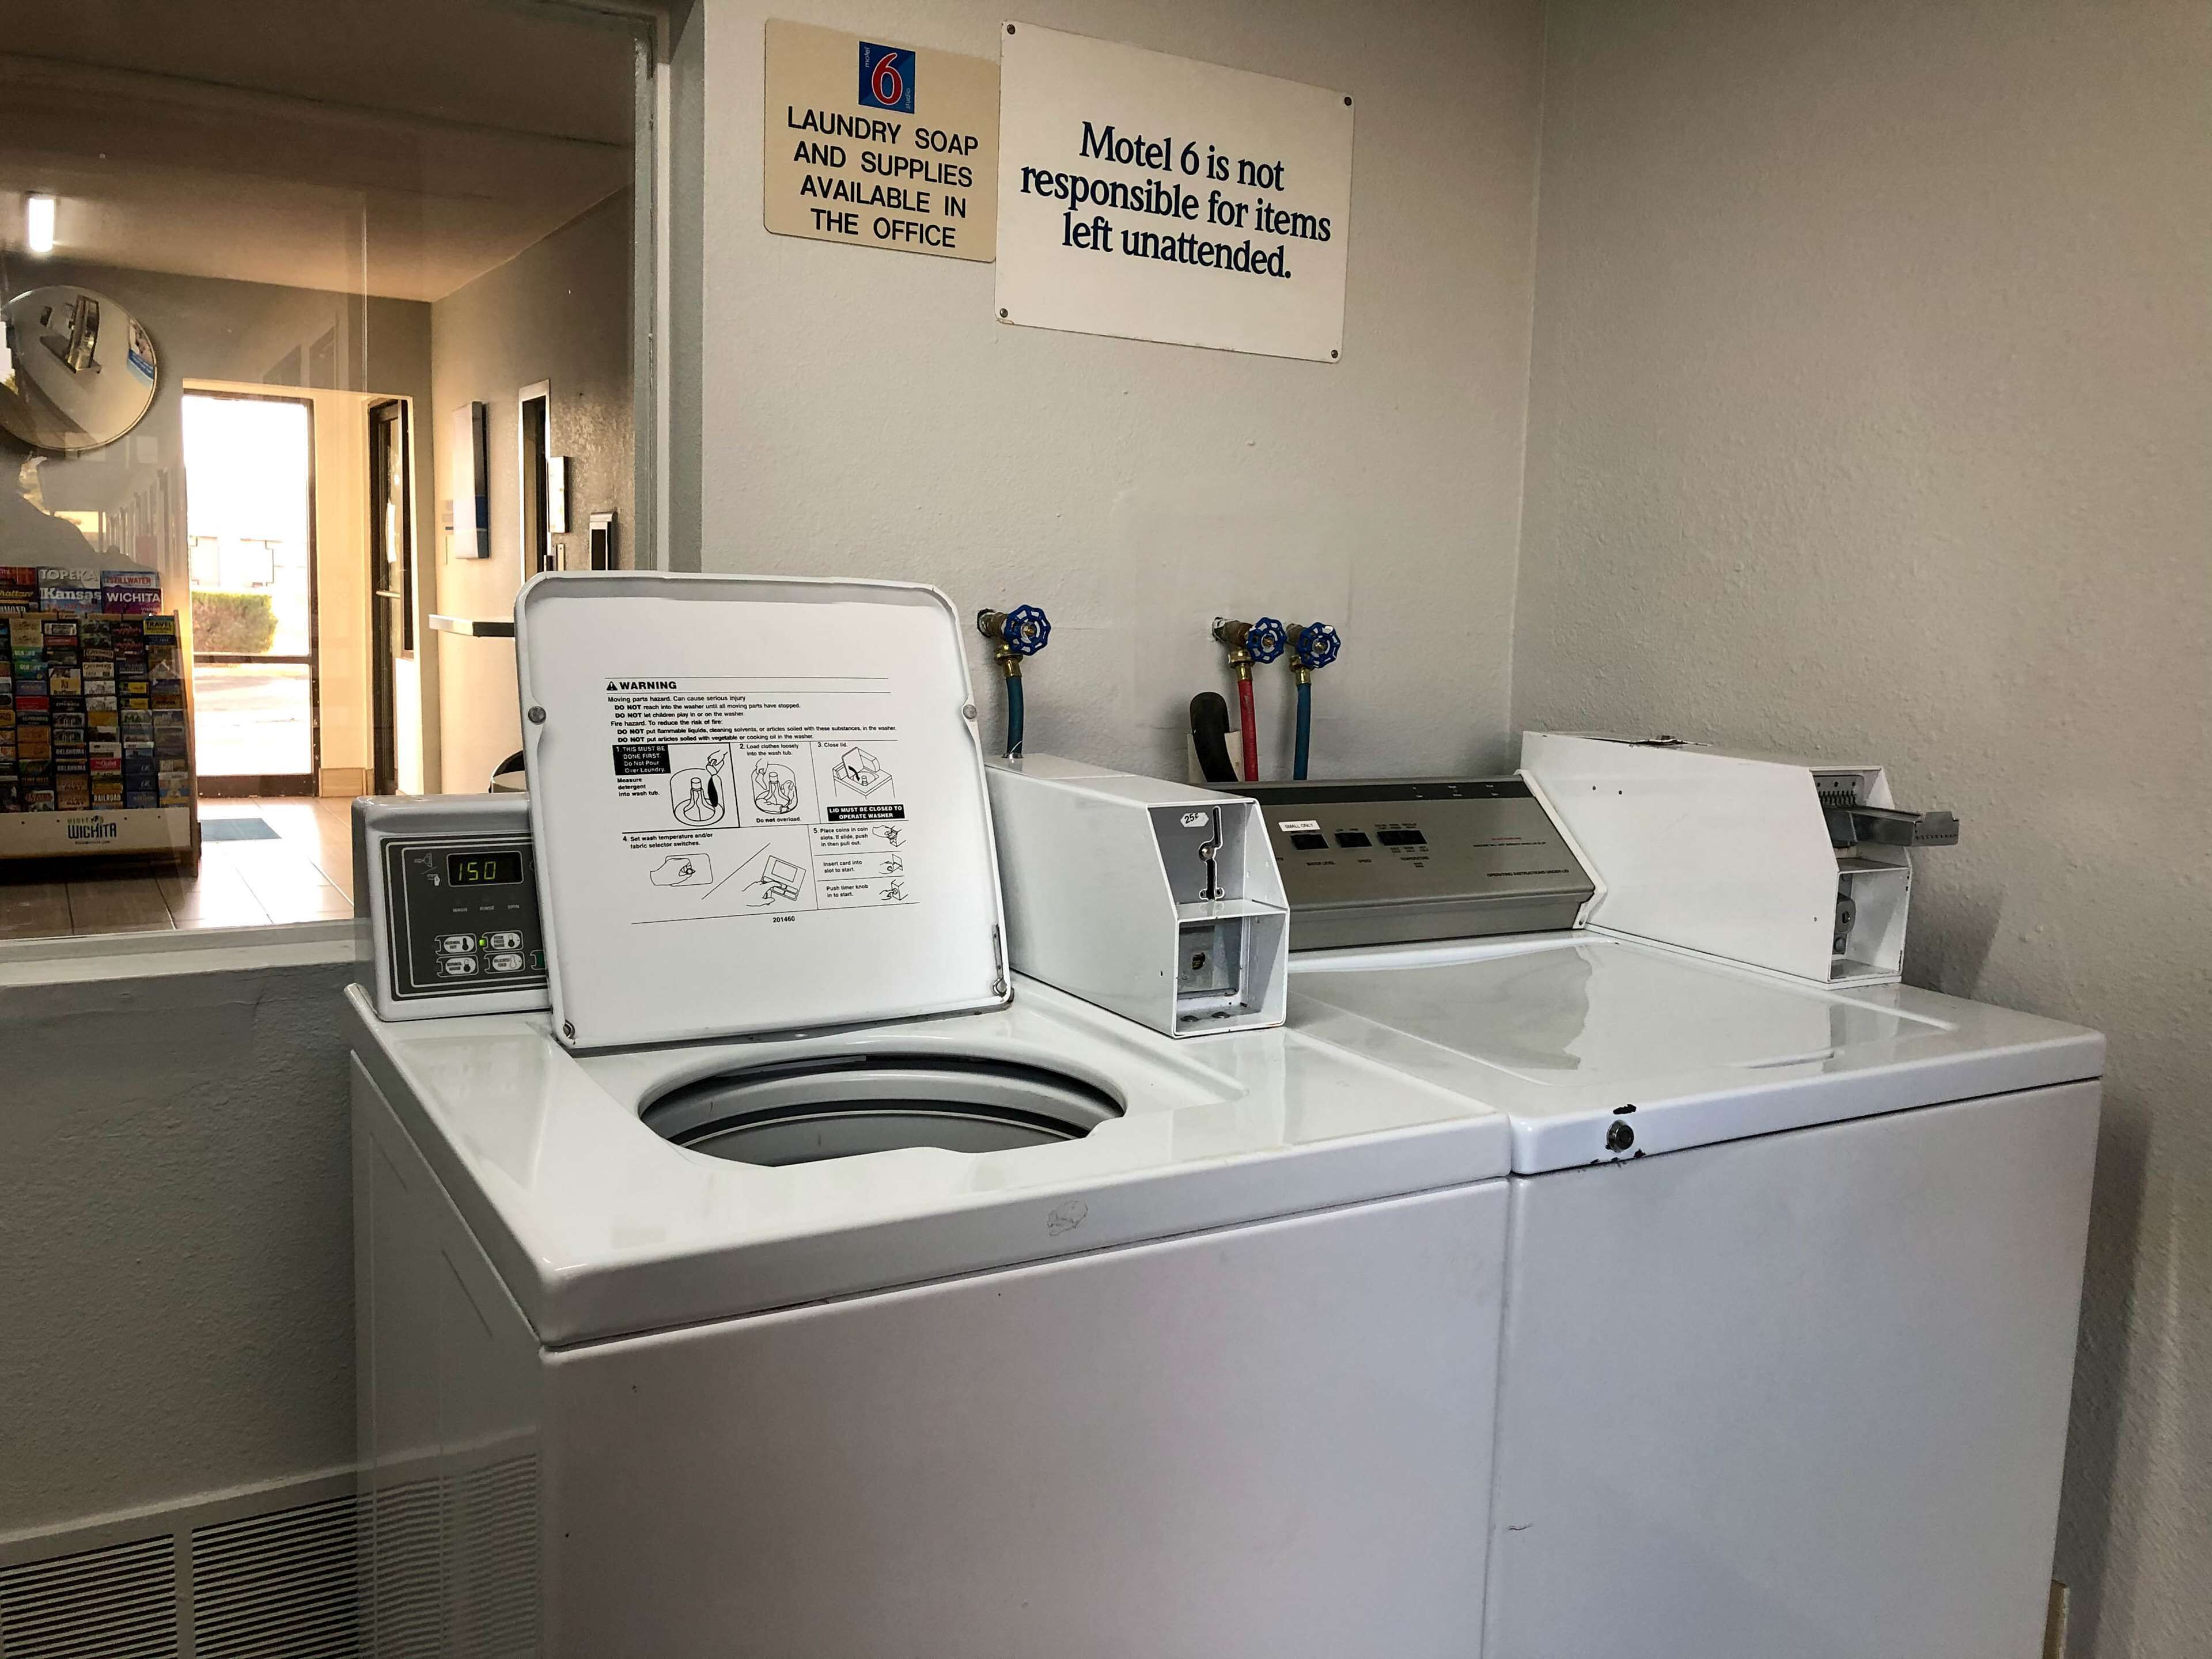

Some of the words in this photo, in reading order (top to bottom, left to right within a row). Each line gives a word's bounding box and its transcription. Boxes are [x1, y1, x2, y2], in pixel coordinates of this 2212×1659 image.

[871, 52, 903, 105] 6
[787, 106, 901, 145] LAUNDRY
[915, 128, 979, 157] SOAP
[794, 141, 846, 168] AND
[861, 151, 974, 188] SUPPLIES
[1079, 122, 1172, 173] Motel
[1180, 143, 1200, 176] 6
[1205, 145, 1230, 181] is
[1236, 157, 1285, 191] not
[801, 175, 930, 214] AVAILABLE
[944, 196, 967, 218] IN
[1020, 164, 1200, 220] responsible
[1207, 190, 1249, 229] for
[1255, 200, 1331, 242] items
[810, 209, 859, 236] THE
[873, 217, 956, 248] OFFICE
[1062, 212, 1113, 254] left
[1122, 228, 1292, 279] unattended.
[40, 569, 98, 582] TOPEKA
[40, 588, 101, 601] Kansas
[107, 592, 161, 603] WICHITA
[619, 681, 677, 690] WARNING
[68, 823, 116, 839] WICHITA
[1184, 813, 1199, 824] 25¢
[458, 861, 497, 881] 150
